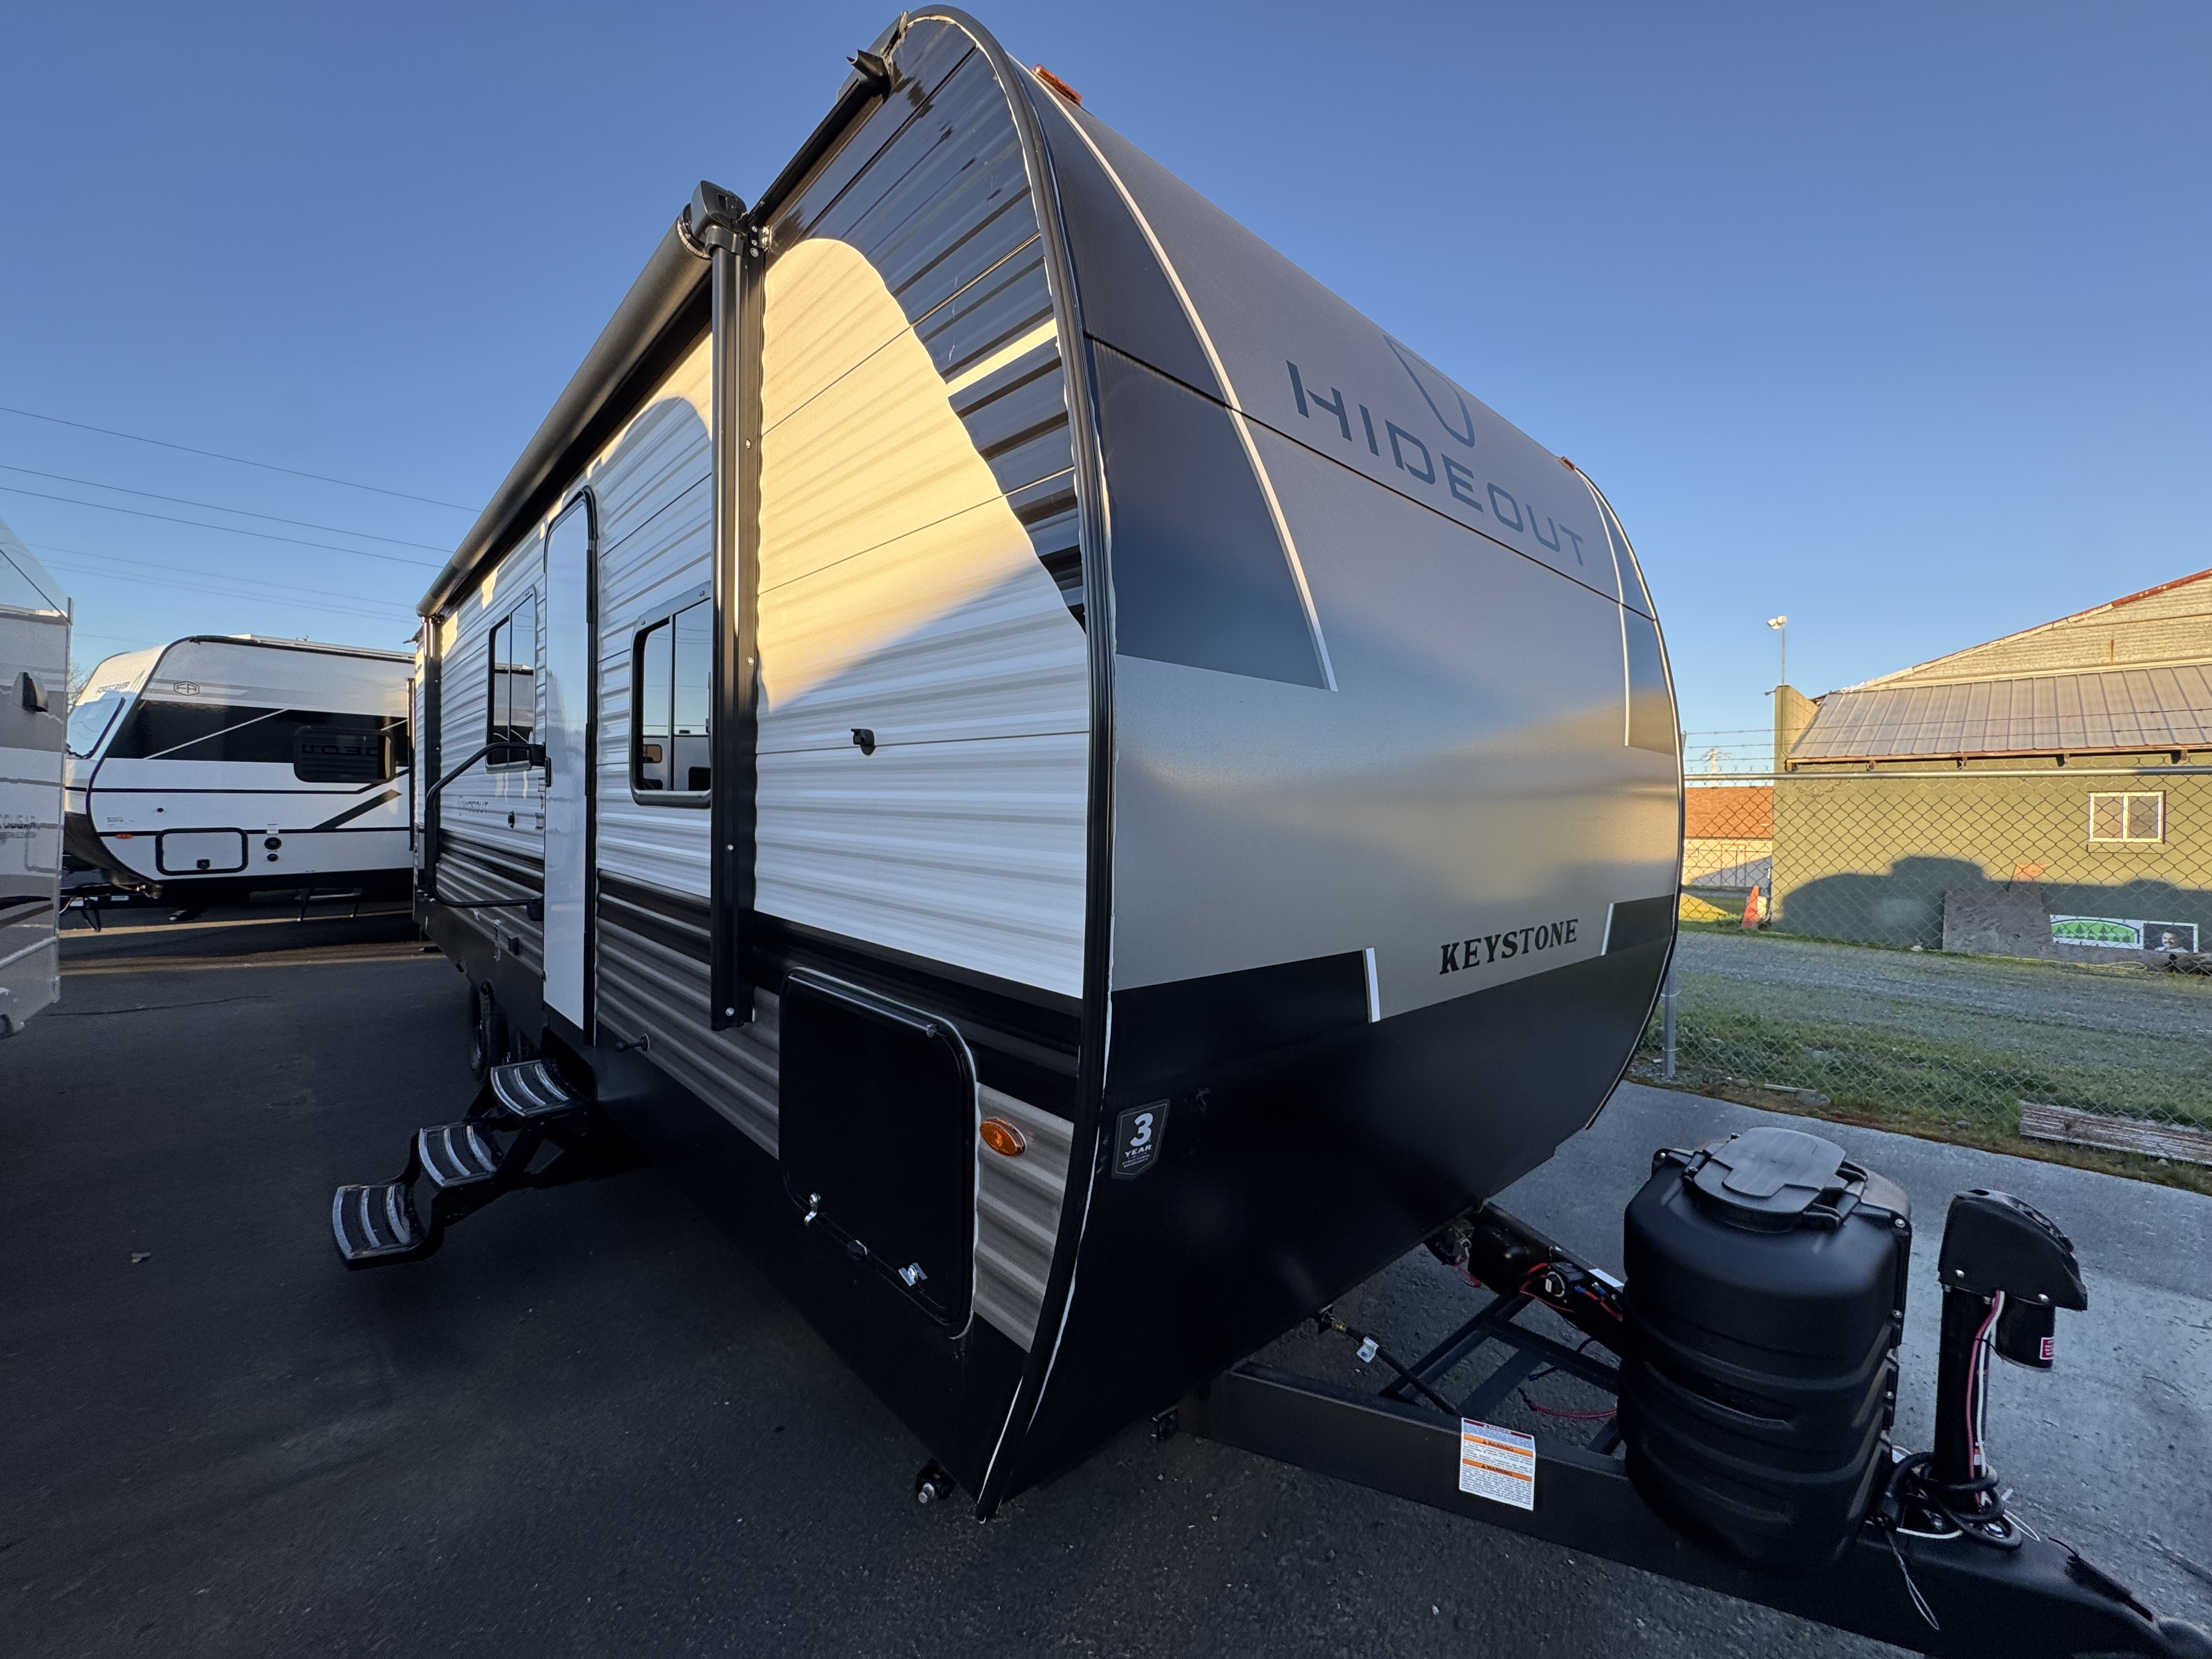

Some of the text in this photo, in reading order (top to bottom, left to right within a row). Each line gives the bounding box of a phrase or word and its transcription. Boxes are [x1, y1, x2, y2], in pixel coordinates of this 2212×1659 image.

[1286, 359, 1584, 567] HIDEOUT
[1439, 918, 1578, 975] KEYSTONE
[1130, 1113, 1153, 1147] 3
[1125, 1144, 1152, 1158] YEAR
[1488, 1440, 1514, 1452] WARNING
[1487, 1464, 1513, 1476] WARNING
